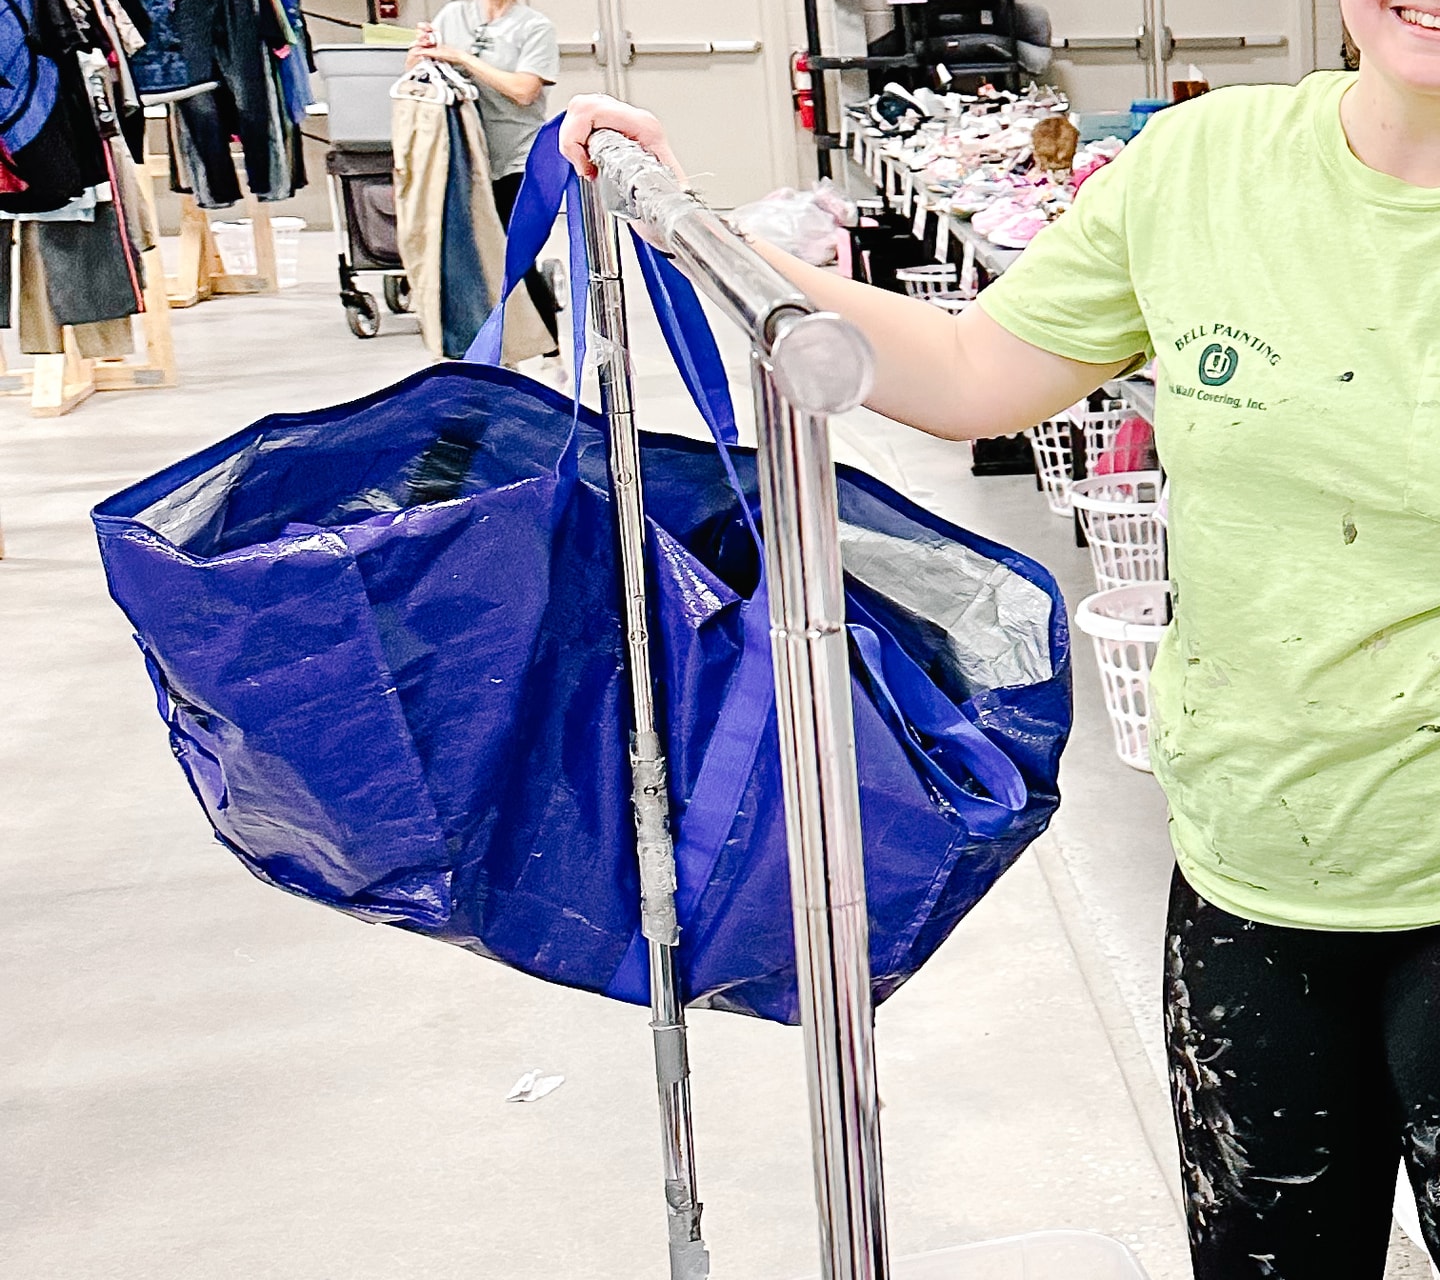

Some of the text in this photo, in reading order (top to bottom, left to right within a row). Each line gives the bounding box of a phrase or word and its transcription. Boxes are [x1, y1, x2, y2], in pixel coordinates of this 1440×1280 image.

[1174, 323, 1282, 367] BELL PAINTING
[1246, 398, 1268, 411] Inc.
